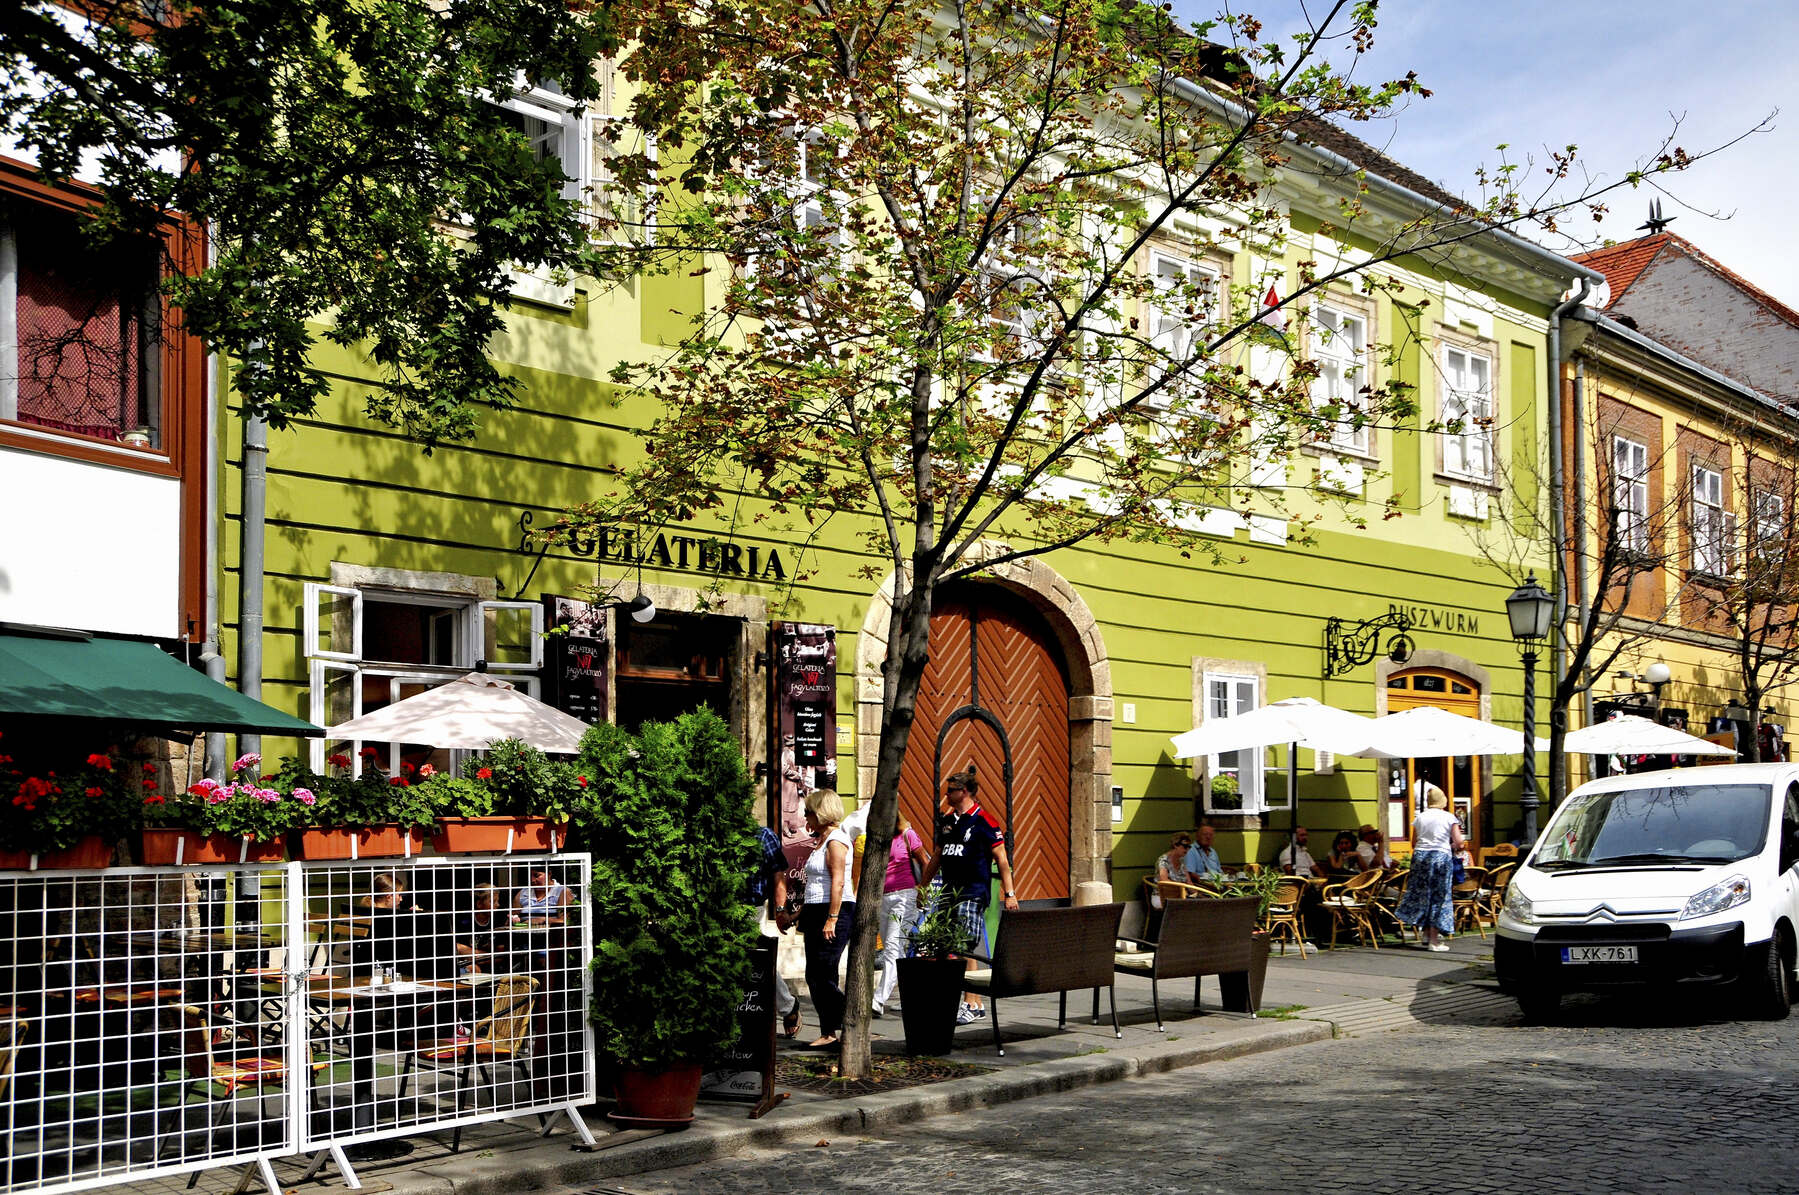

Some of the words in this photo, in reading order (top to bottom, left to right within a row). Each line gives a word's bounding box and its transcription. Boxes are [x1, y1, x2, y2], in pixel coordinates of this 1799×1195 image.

[567, 525, 788, 580] GELATERIA
[1388, 604, 1479, 634] RUSZWURM
[567, 644, 598, 657] GELATERIA
[792, 664, 825, 674] GELATERIA
[942, 843, 964, 856] GBR
[1571, 948, 1634, 960] LXK-761
